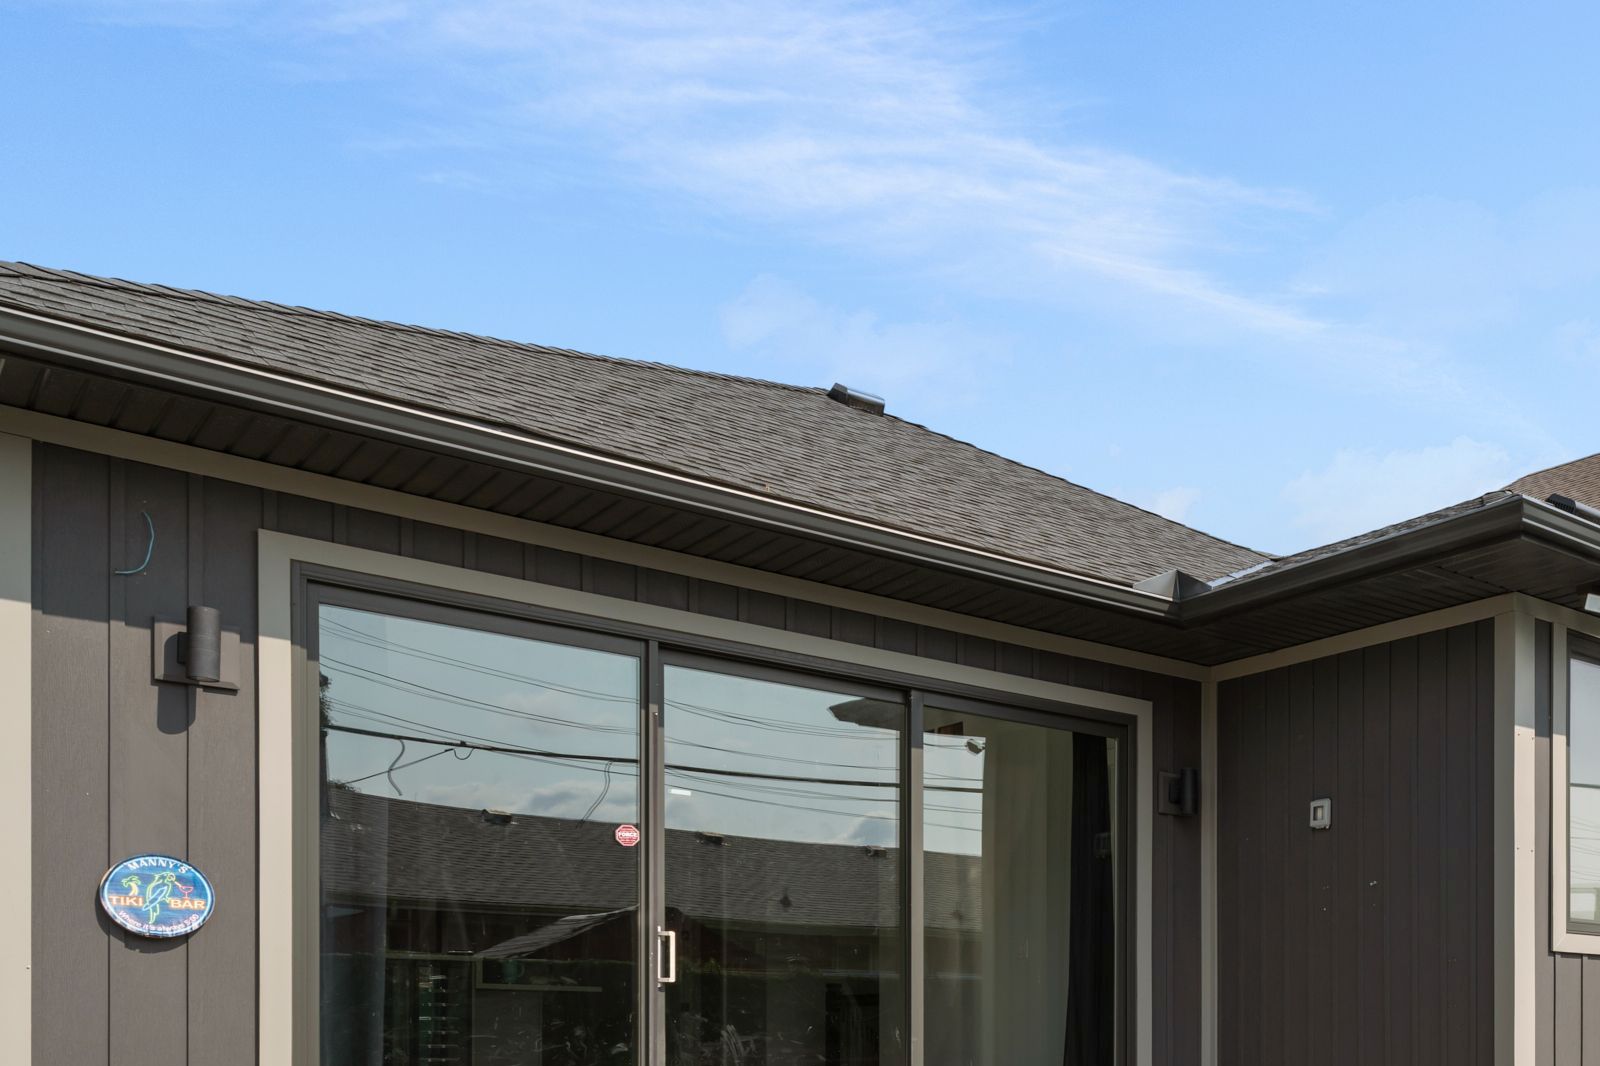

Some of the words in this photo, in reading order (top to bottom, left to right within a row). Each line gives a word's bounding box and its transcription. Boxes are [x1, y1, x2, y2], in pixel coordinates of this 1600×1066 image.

[127, 858, 189, 874] MANNY'S
[109, 895, 144, 906] TIKI
[170, 898, 206, 910] BAR
